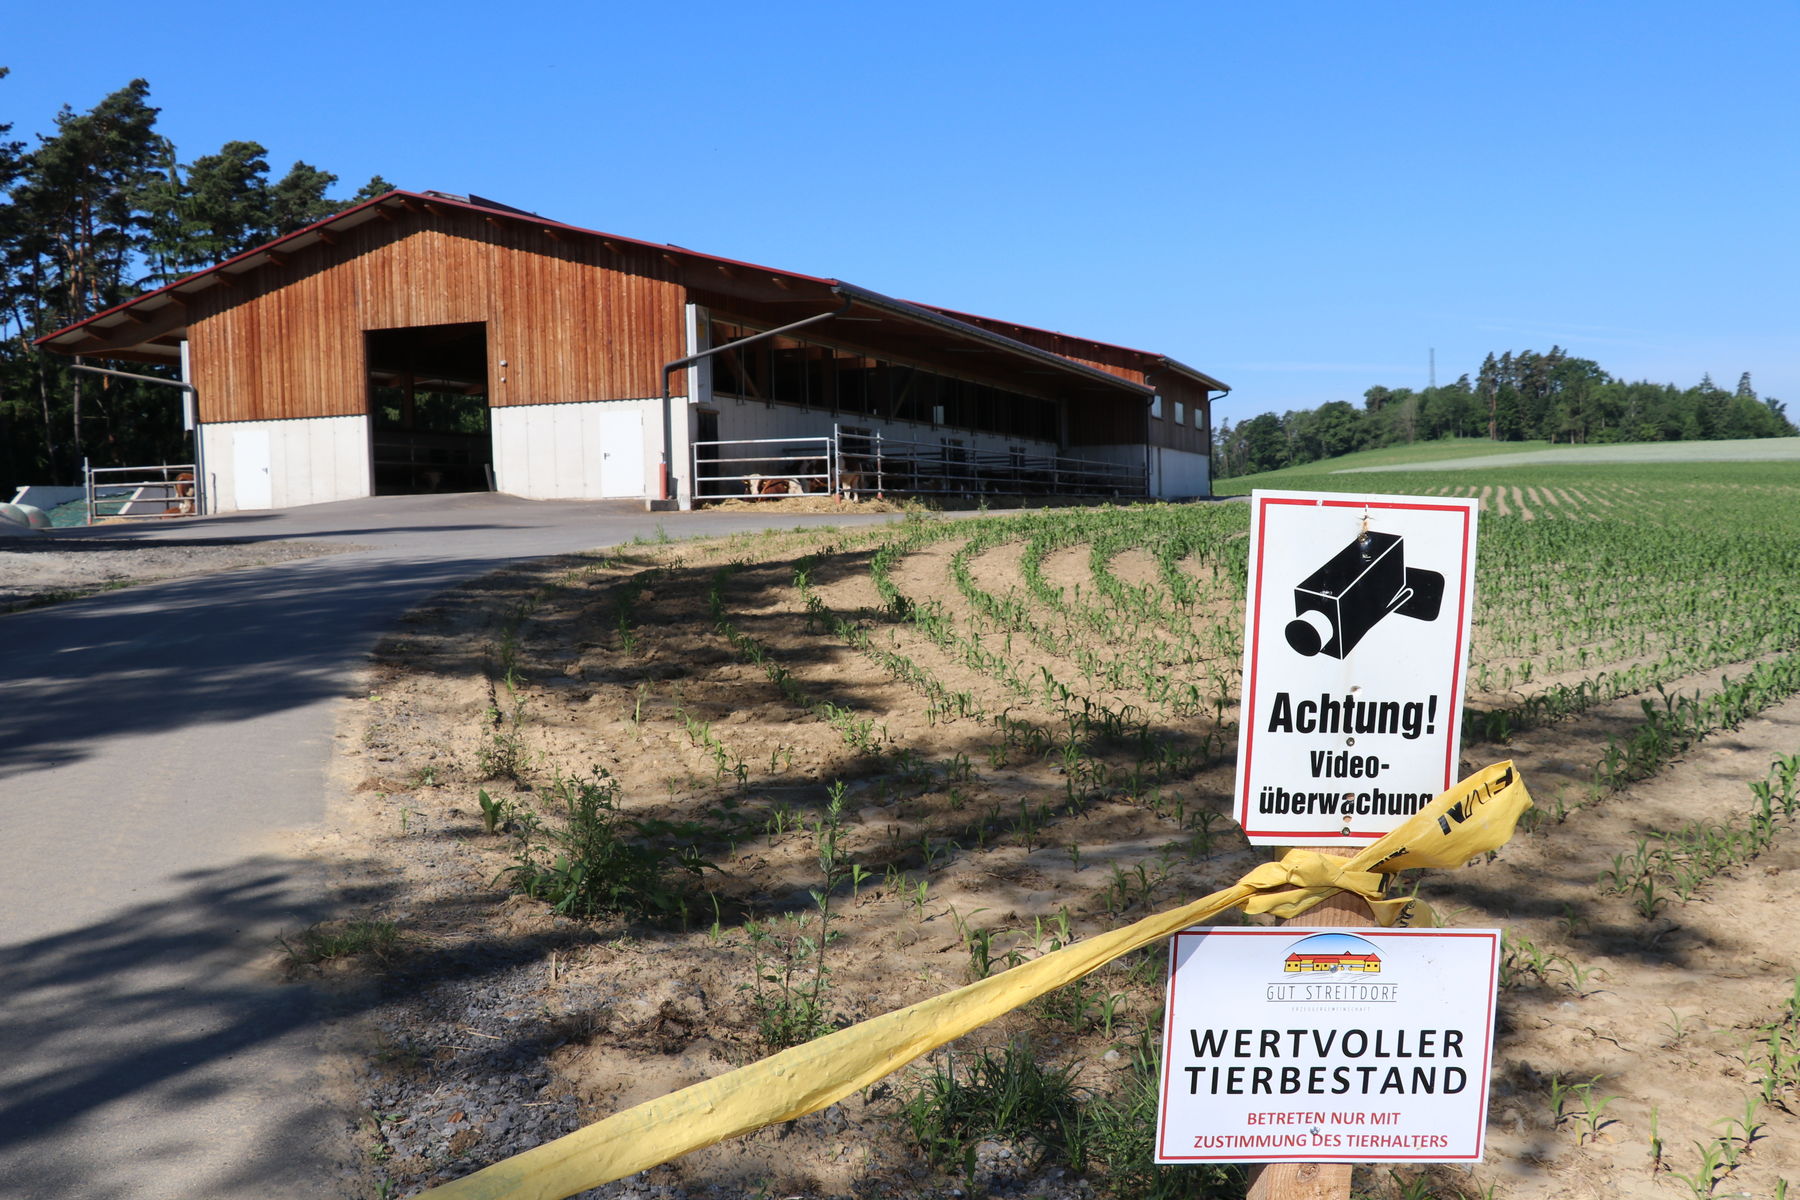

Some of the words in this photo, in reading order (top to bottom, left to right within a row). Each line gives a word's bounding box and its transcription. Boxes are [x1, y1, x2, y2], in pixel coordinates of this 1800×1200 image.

[1268, 691, 1438, 740] Achtung!
[1310, 750, 1390, 779] Video-
[1267, 985, 1296, 1001] GUT
[1306, 985, 1398, 1001] STREITDORF
[1190, 1029, 1464, 1059] WERTVOLLER
[1185, 1066, 1467, 1095] TIERBESTAND
[1247, 1112, 1326, 1125] BETRETEN
[1330, 1112, 1367, 1125] NUR
[1370, 1112, 1402, 1125] MIT
[1193, 1134, 1308, 1149] ZUSTIMMUNG
[1312, 1134, 1343, 1148] DES
[1345, 1134, 1449, 1149] TIERHALTERS
